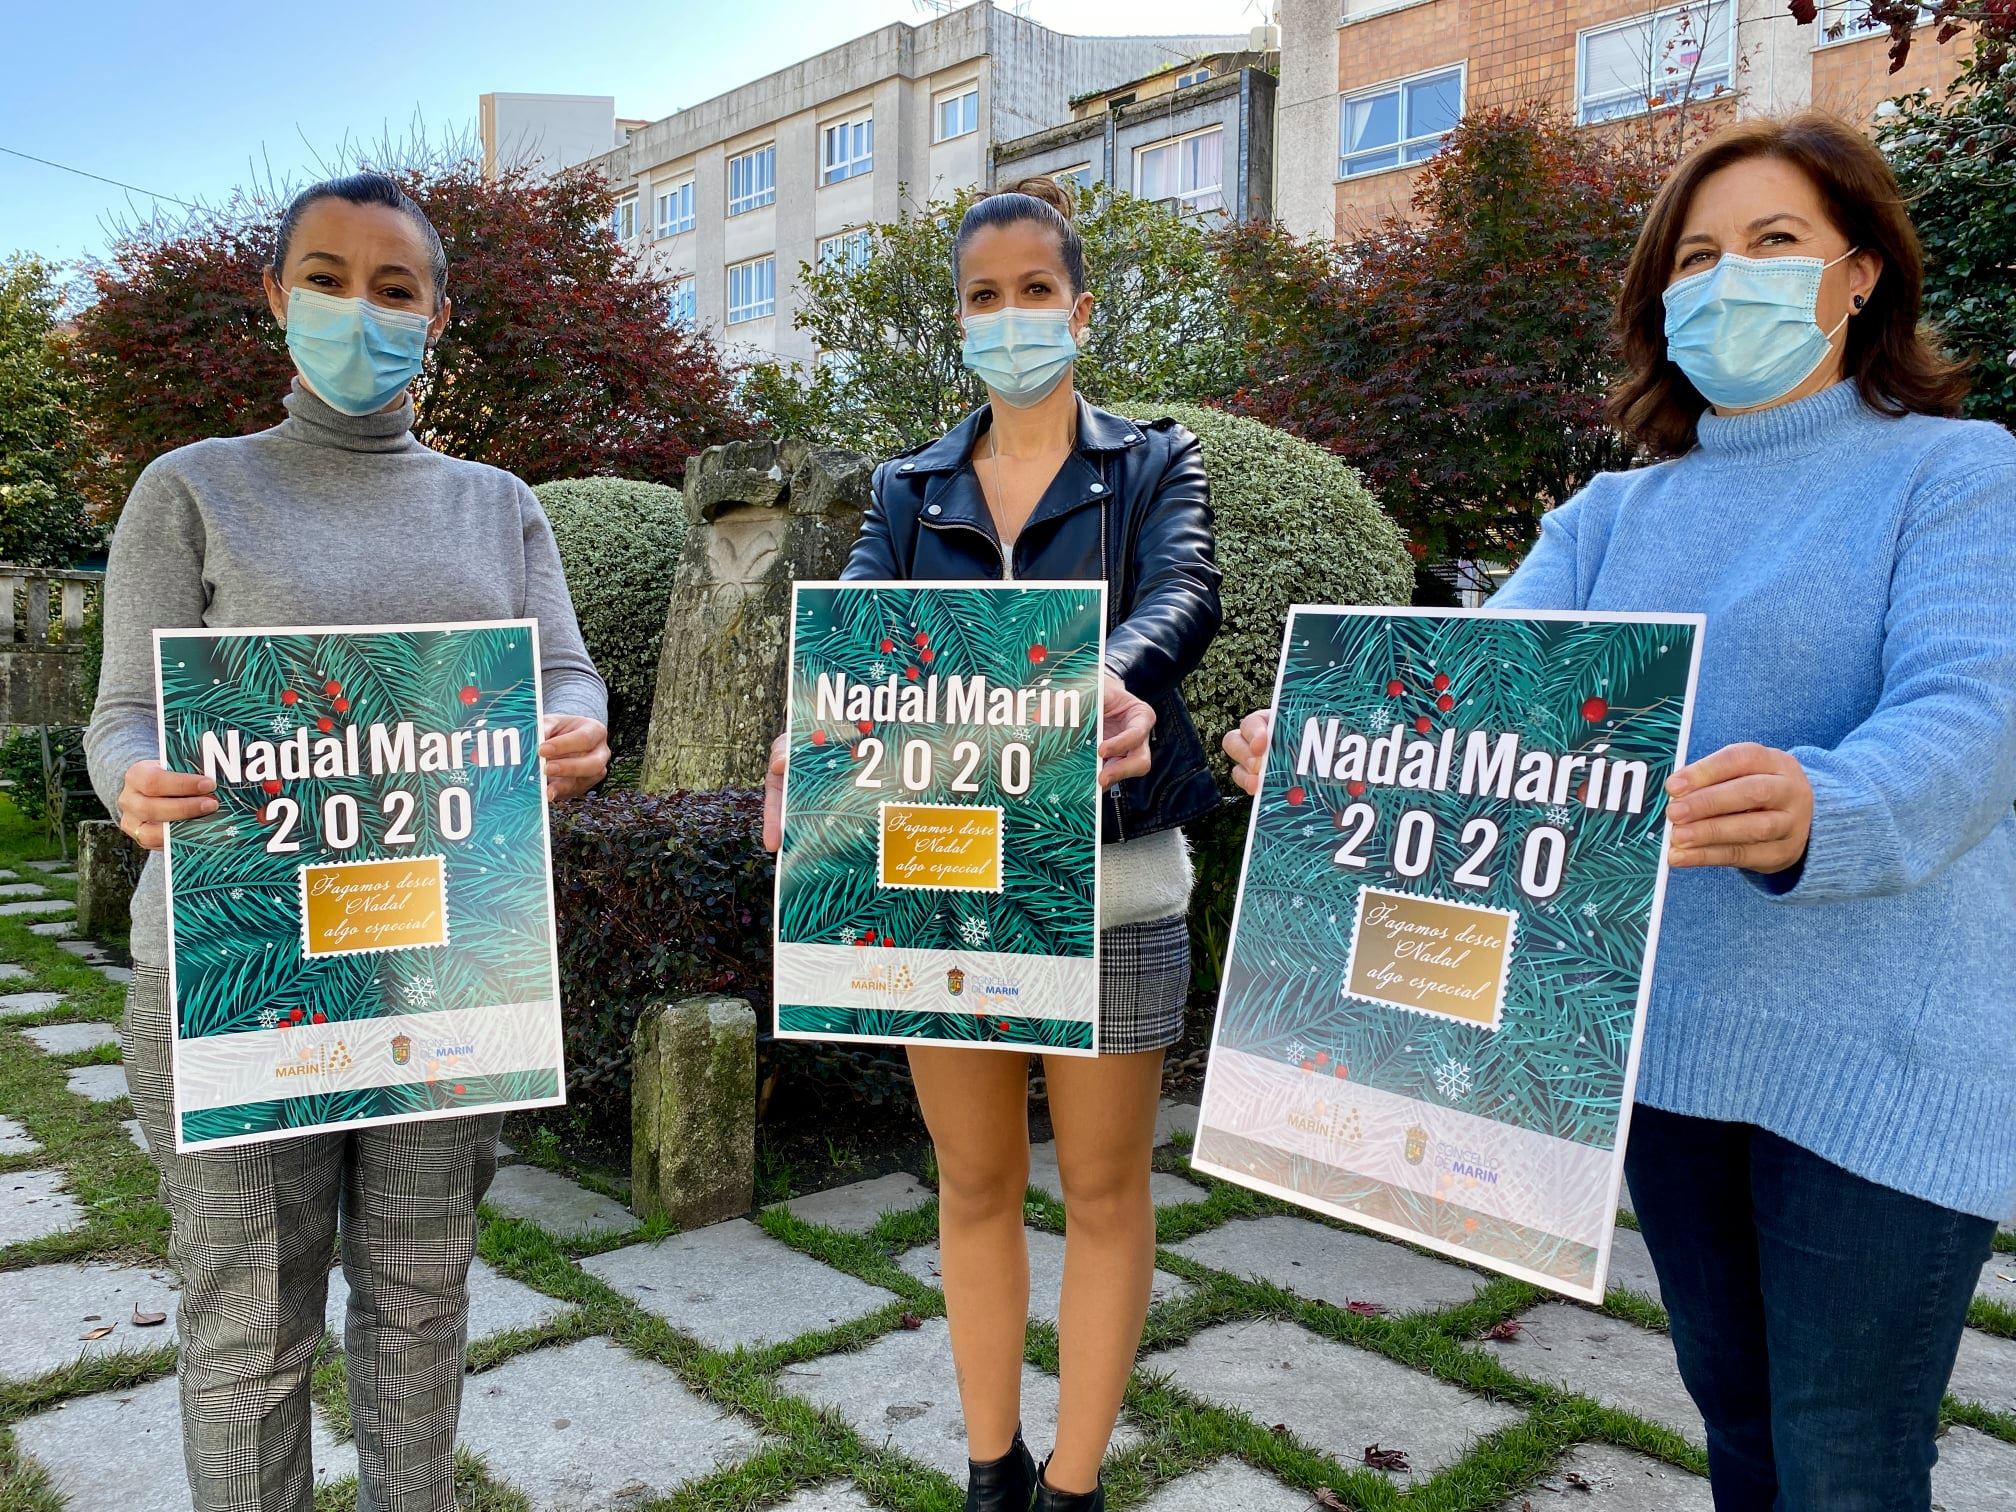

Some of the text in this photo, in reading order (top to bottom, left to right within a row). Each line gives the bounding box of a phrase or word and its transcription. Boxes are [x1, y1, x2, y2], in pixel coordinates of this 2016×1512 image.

[817, 672, 1080, 728] Nadal Marín
[202, 719, 521, 784] Nadal Marín
[1296, 716, 1648, 814] Nadal Marín
[887, 812, 995, 839] Fagamos deste
[914, 836, 973, 854] Nadal
[896, 856, 992, 880] algo especial
[310, 871, 437, 902] Fagamos deste
[345, 892, 413, 915] Nadal
[323, 910, 436, 945] algo especial
[1364, 901, 1502, 949] Fagamos deste
[1394, 939, 1471, 969] Nadal
[1366, 961, 1491, 1001] algo especial
